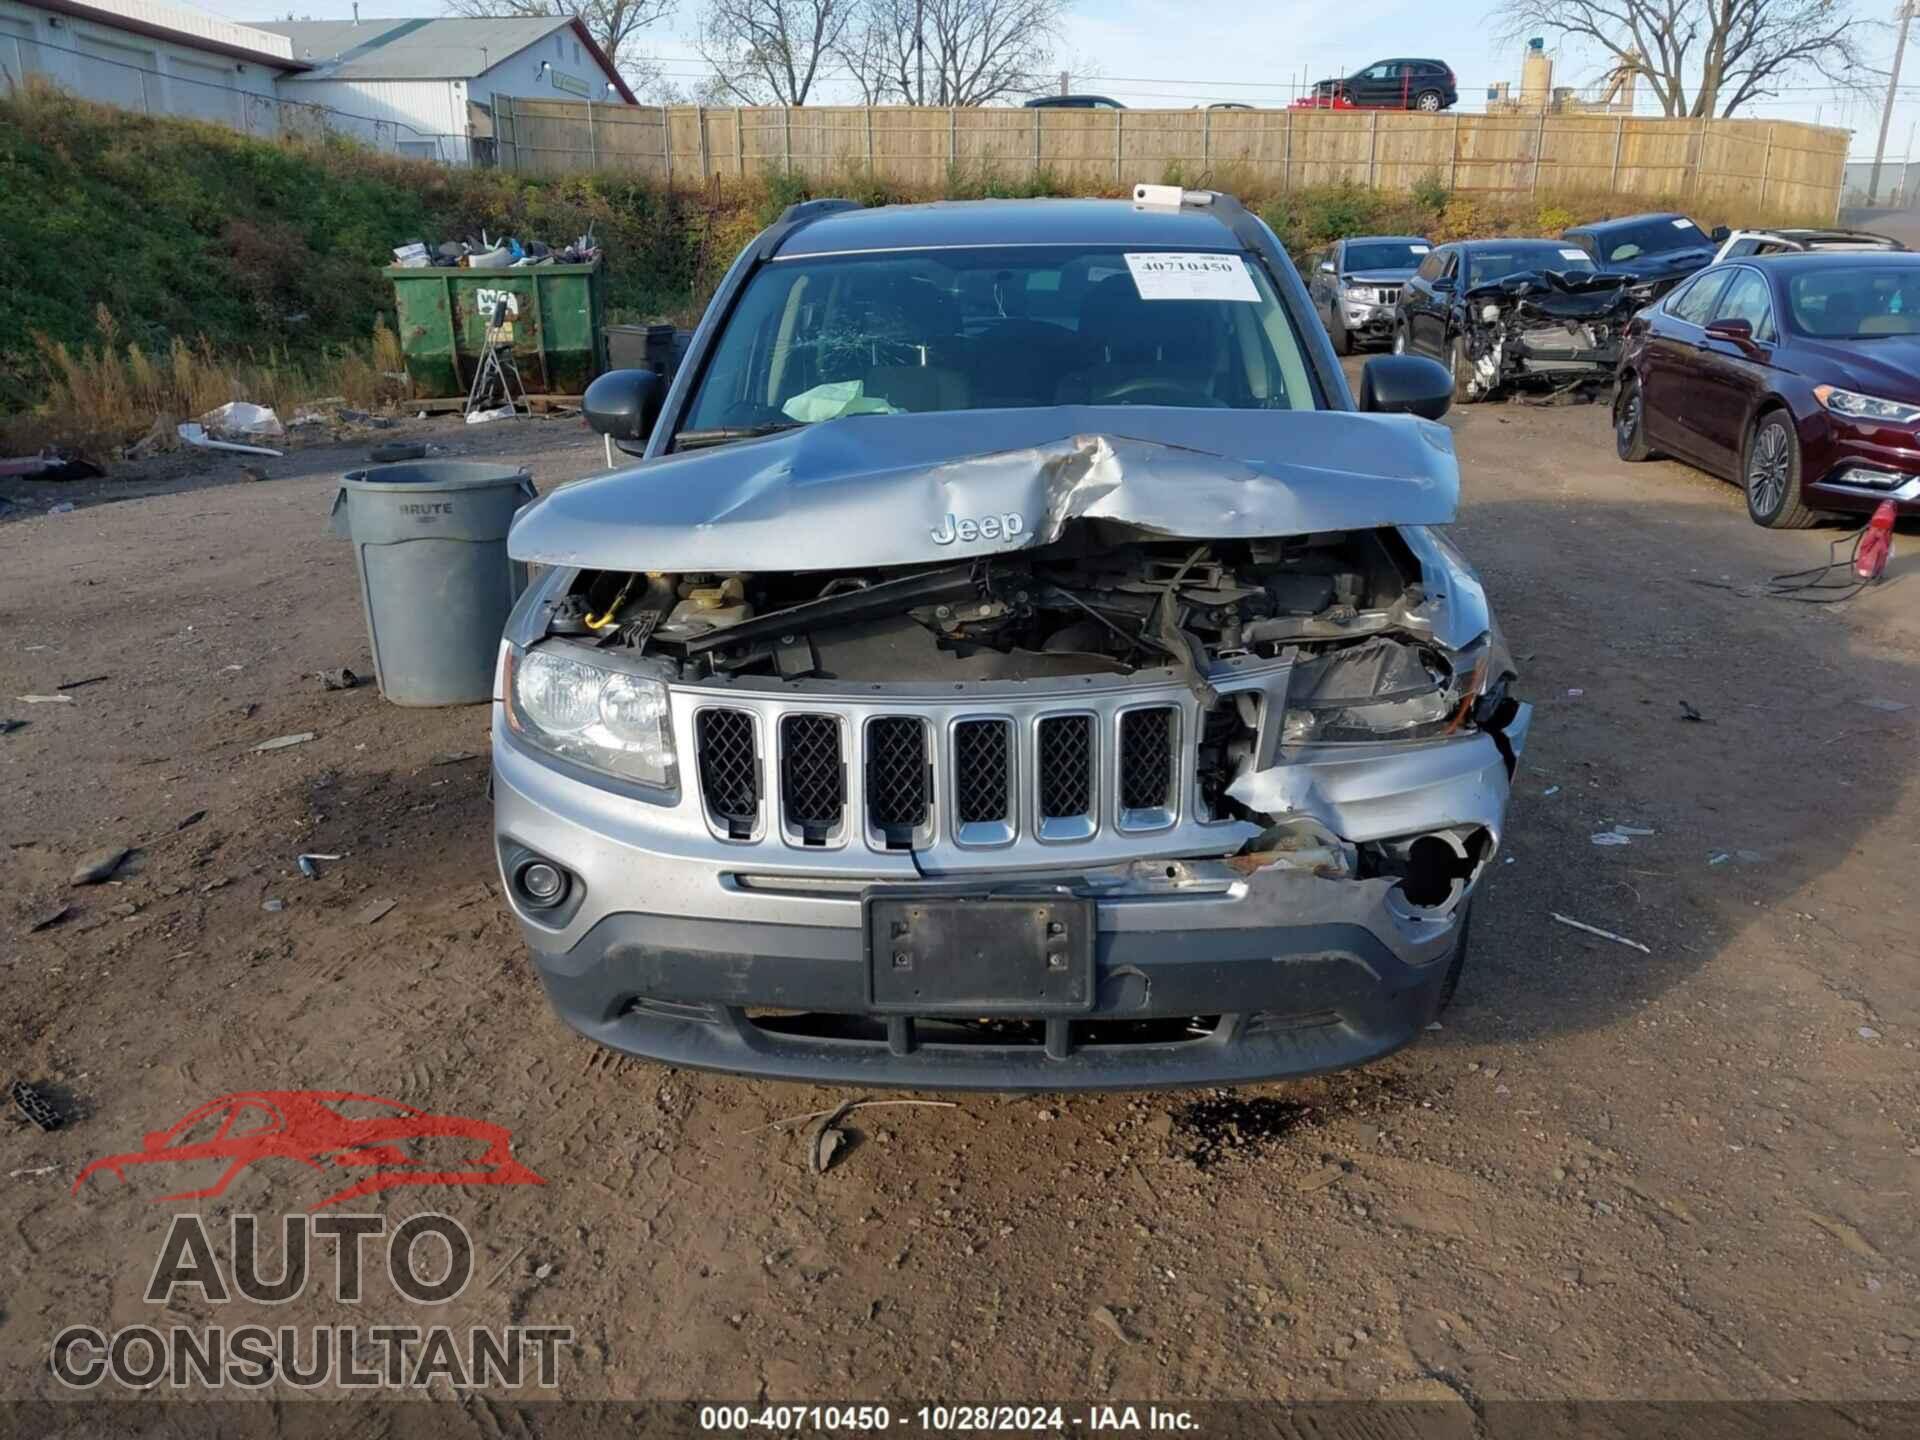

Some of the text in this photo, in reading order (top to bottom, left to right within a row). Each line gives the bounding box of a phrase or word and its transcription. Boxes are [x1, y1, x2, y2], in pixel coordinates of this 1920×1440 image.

[1142, 261, 1232, 272] 40710450
[399, 503, 452, 514] BRUTE
[930, 511, 1024, 545] Jeep
